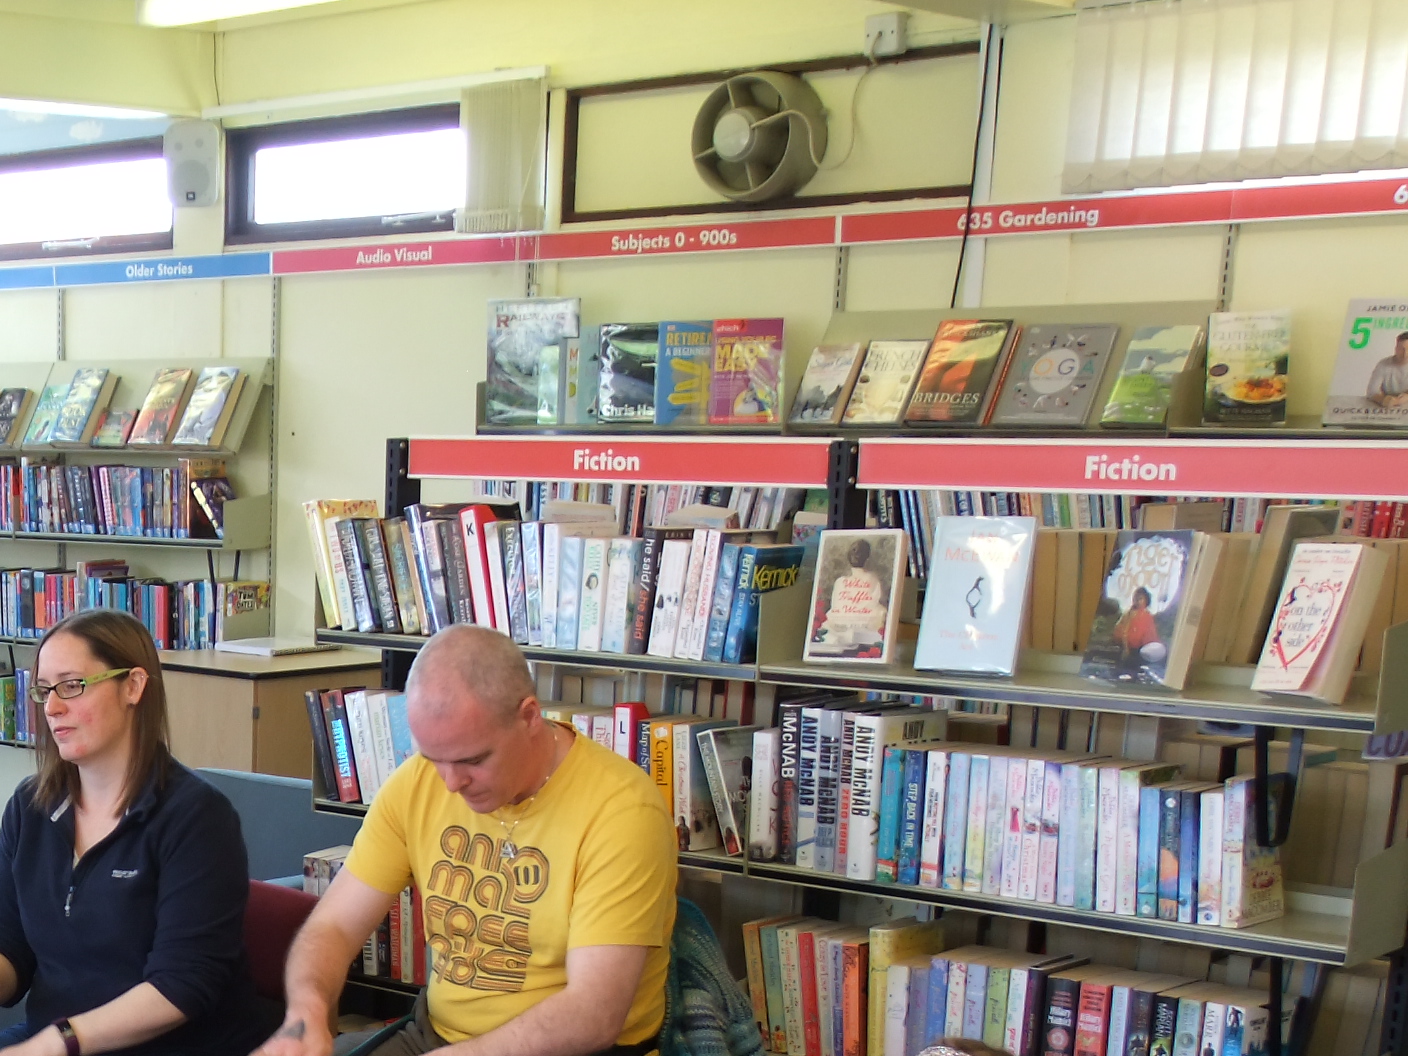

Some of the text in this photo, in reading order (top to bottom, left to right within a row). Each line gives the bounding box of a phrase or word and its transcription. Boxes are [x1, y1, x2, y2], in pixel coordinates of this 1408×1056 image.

[956, 206, 1099, 231] 635 Gardening
[610, 233, 671, 254] Subjects
[699, 228, 737, 246] 900s
[356, 247, 433, 265] Audio Visual
[125, 261, 193, 278] Older Stories
[1367, 304, 1396, 312] JAMIE
[1348, 316, 1373, 349] 5
[1021, 358, 1095, 376] YOGA
[913, 392, 980, 404] BRIDGES
[573, 450, 640, 472] Fiction
[1085, 456, 1177, 482] Fiction
[466, 524, 475, 536] K
[645, 538, 655, 553] he
[753, 564, 799, 590] Kernick
[842, 579, 870, 589] White
[838, 591, 873, 603] Truffles
[842, 605, 873, 615] Winter
[1291, 604, 1322, 616] on the
[1288, 619, 1314, 632] other
[1286, 638, 1305, 648] side
[620, 721, 626, 734] L
[639, 723, 650, 746] Map
[843, 719, 854, 750] ANDY
[781, 714, 797, 779] McNAB
[820, 735, 838, 775] ANDY
[653, 740, 668, 786] Capital
[800, 716, 818, 807] ANDY McNAB
[840, 750, 853, 784] McNAB
[850, 726, 876, 817] ANDY McNAB
[817, 776, 838, 824] McNAB
[907, 783, 918, 804] STEP
[1022, 837, 1030, 884] Christmas
[1155, 1003, 1167, 1039] MARIANI
[1204, 1009, 1216, 1037] MARR
